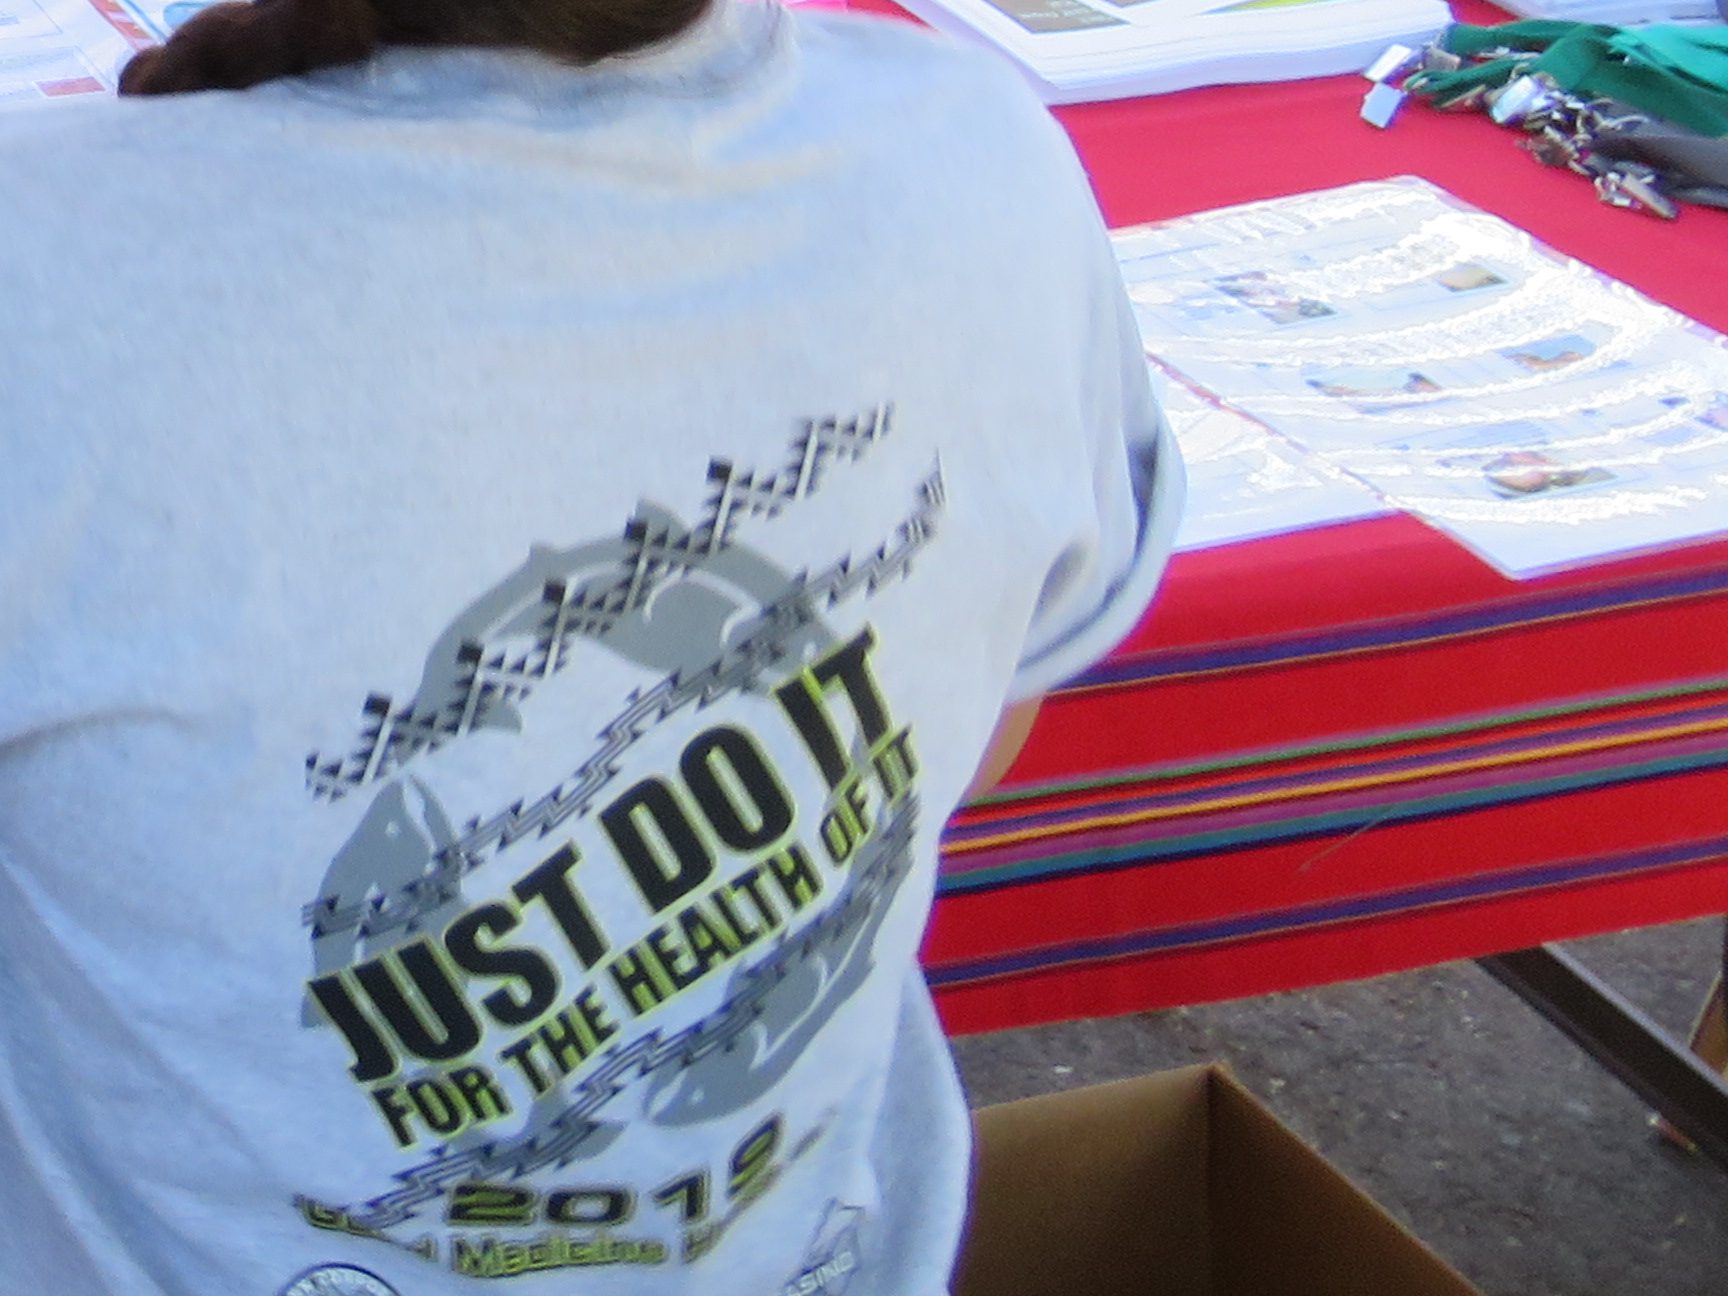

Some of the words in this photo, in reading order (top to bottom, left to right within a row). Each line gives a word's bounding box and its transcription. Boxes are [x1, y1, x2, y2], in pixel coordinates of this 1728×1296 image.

[308, 838, 613, 1084] JUST
[598, 722, 799, 916] DO
[772, 622, 895, 798] IT
[371, 1061, 513, 1150] FOR
[497, 984, 621, 1101] THE
[608, 840, 824, 1017] HEALTH
[818, 780, 874, 869] OF
[872, 724, 918, 808] IT
[781, 1250, 857, 1296] ASINO
